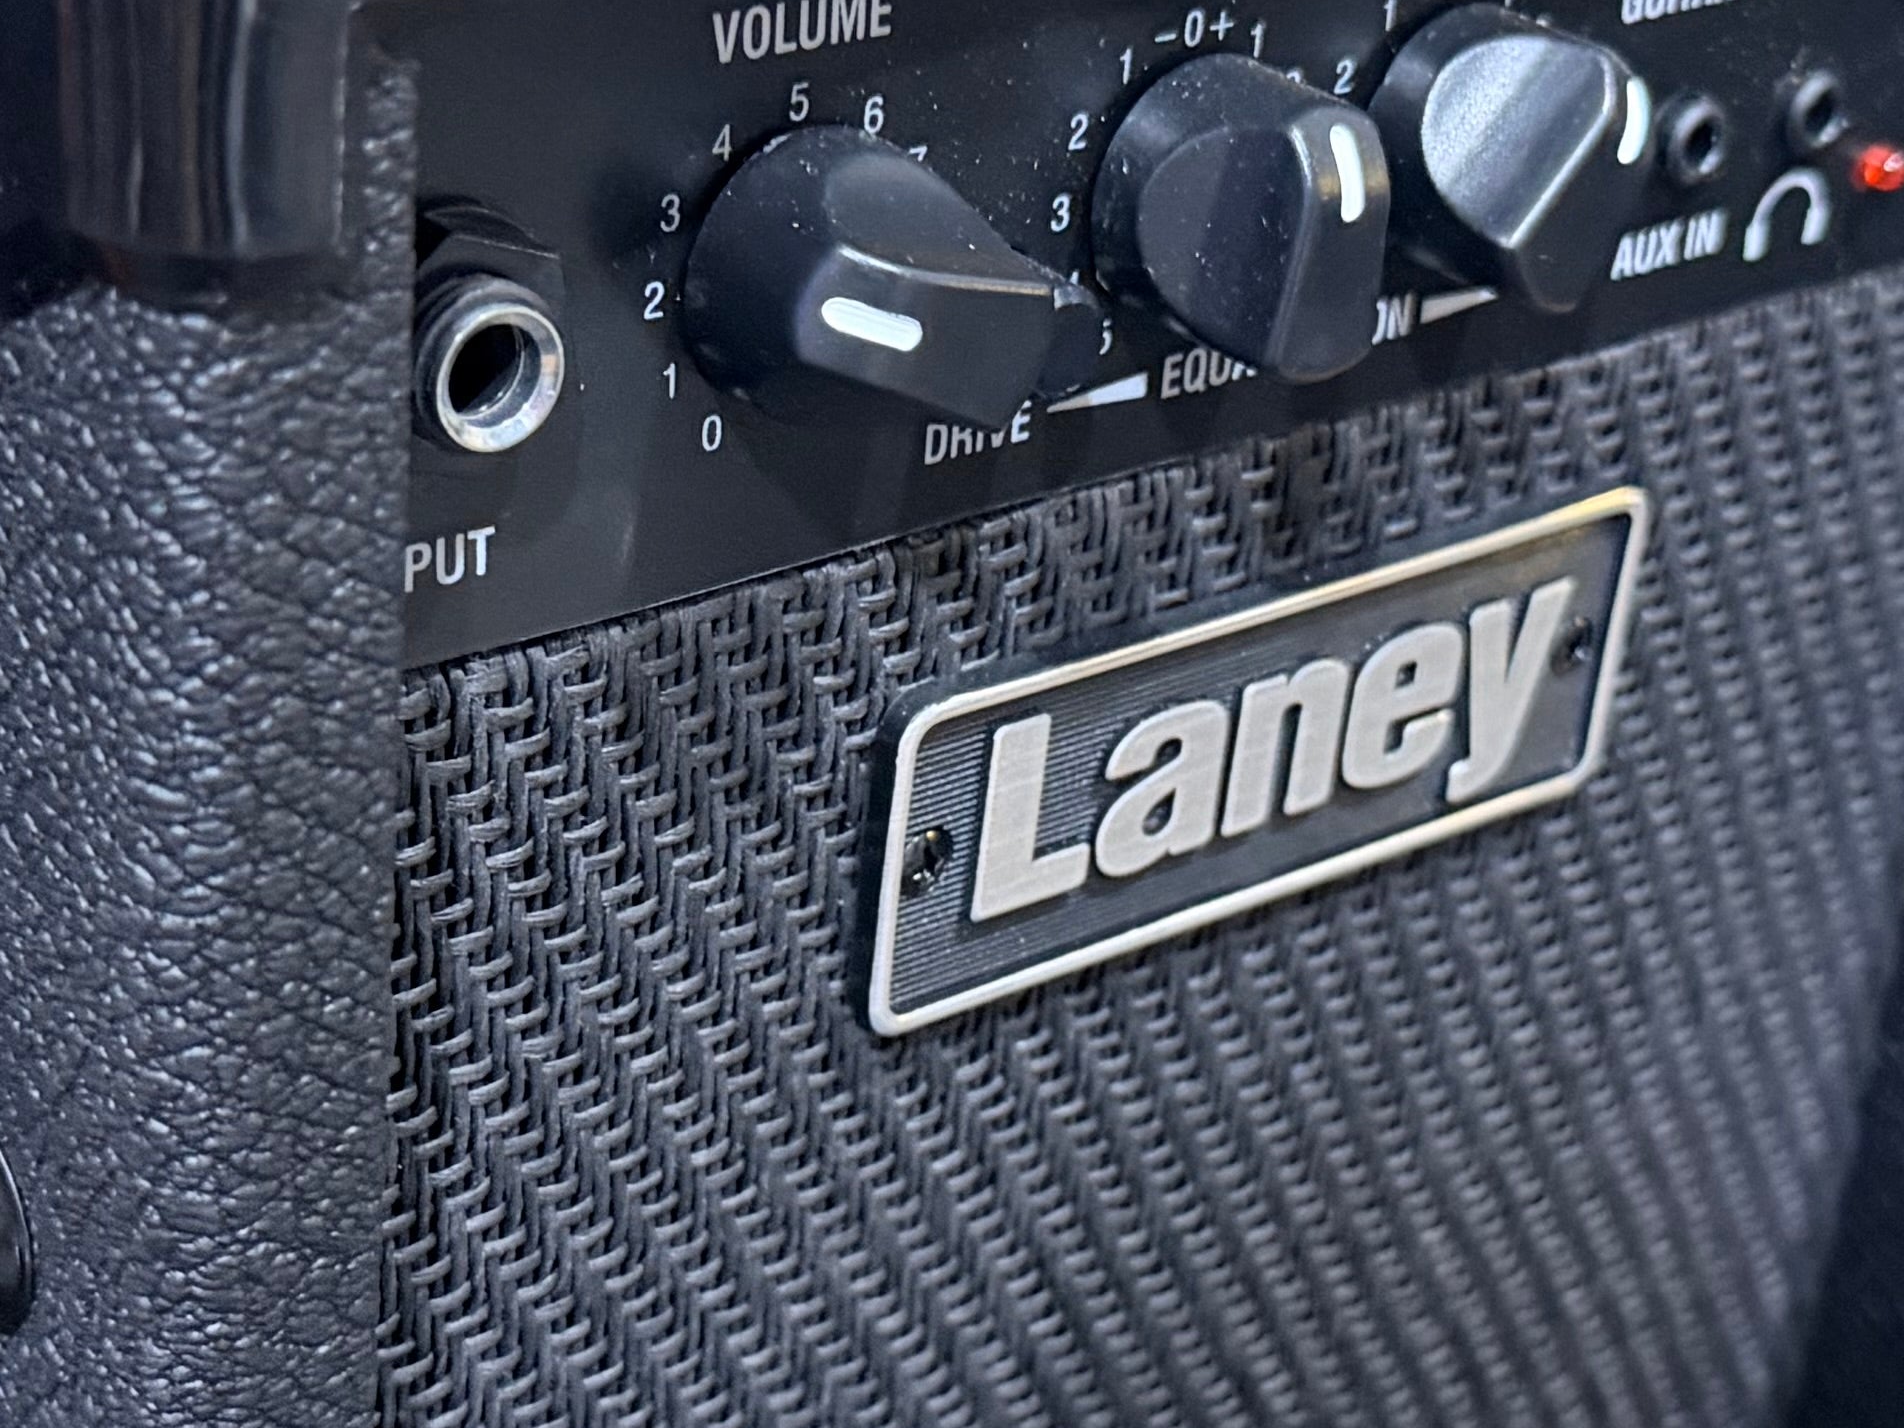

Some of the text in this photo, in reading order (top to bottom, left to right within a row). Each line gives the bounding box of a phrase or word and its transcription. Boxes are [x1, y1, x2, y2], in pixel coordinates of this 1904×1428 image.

[1050, 192, 1072, 233] 3
[1067, 111, 1090, 151] 2
[1119, 47, 1134, 86] 1
[1250, 20, 1267, 58] 1
[1333, 58, 1357, 96] 2
[642, 81, 885, 453] 0 1 2 3 4 5 6
[1610, 205, 1729, 281] AUX IN
[968, 574, 1576, 923] Laney
